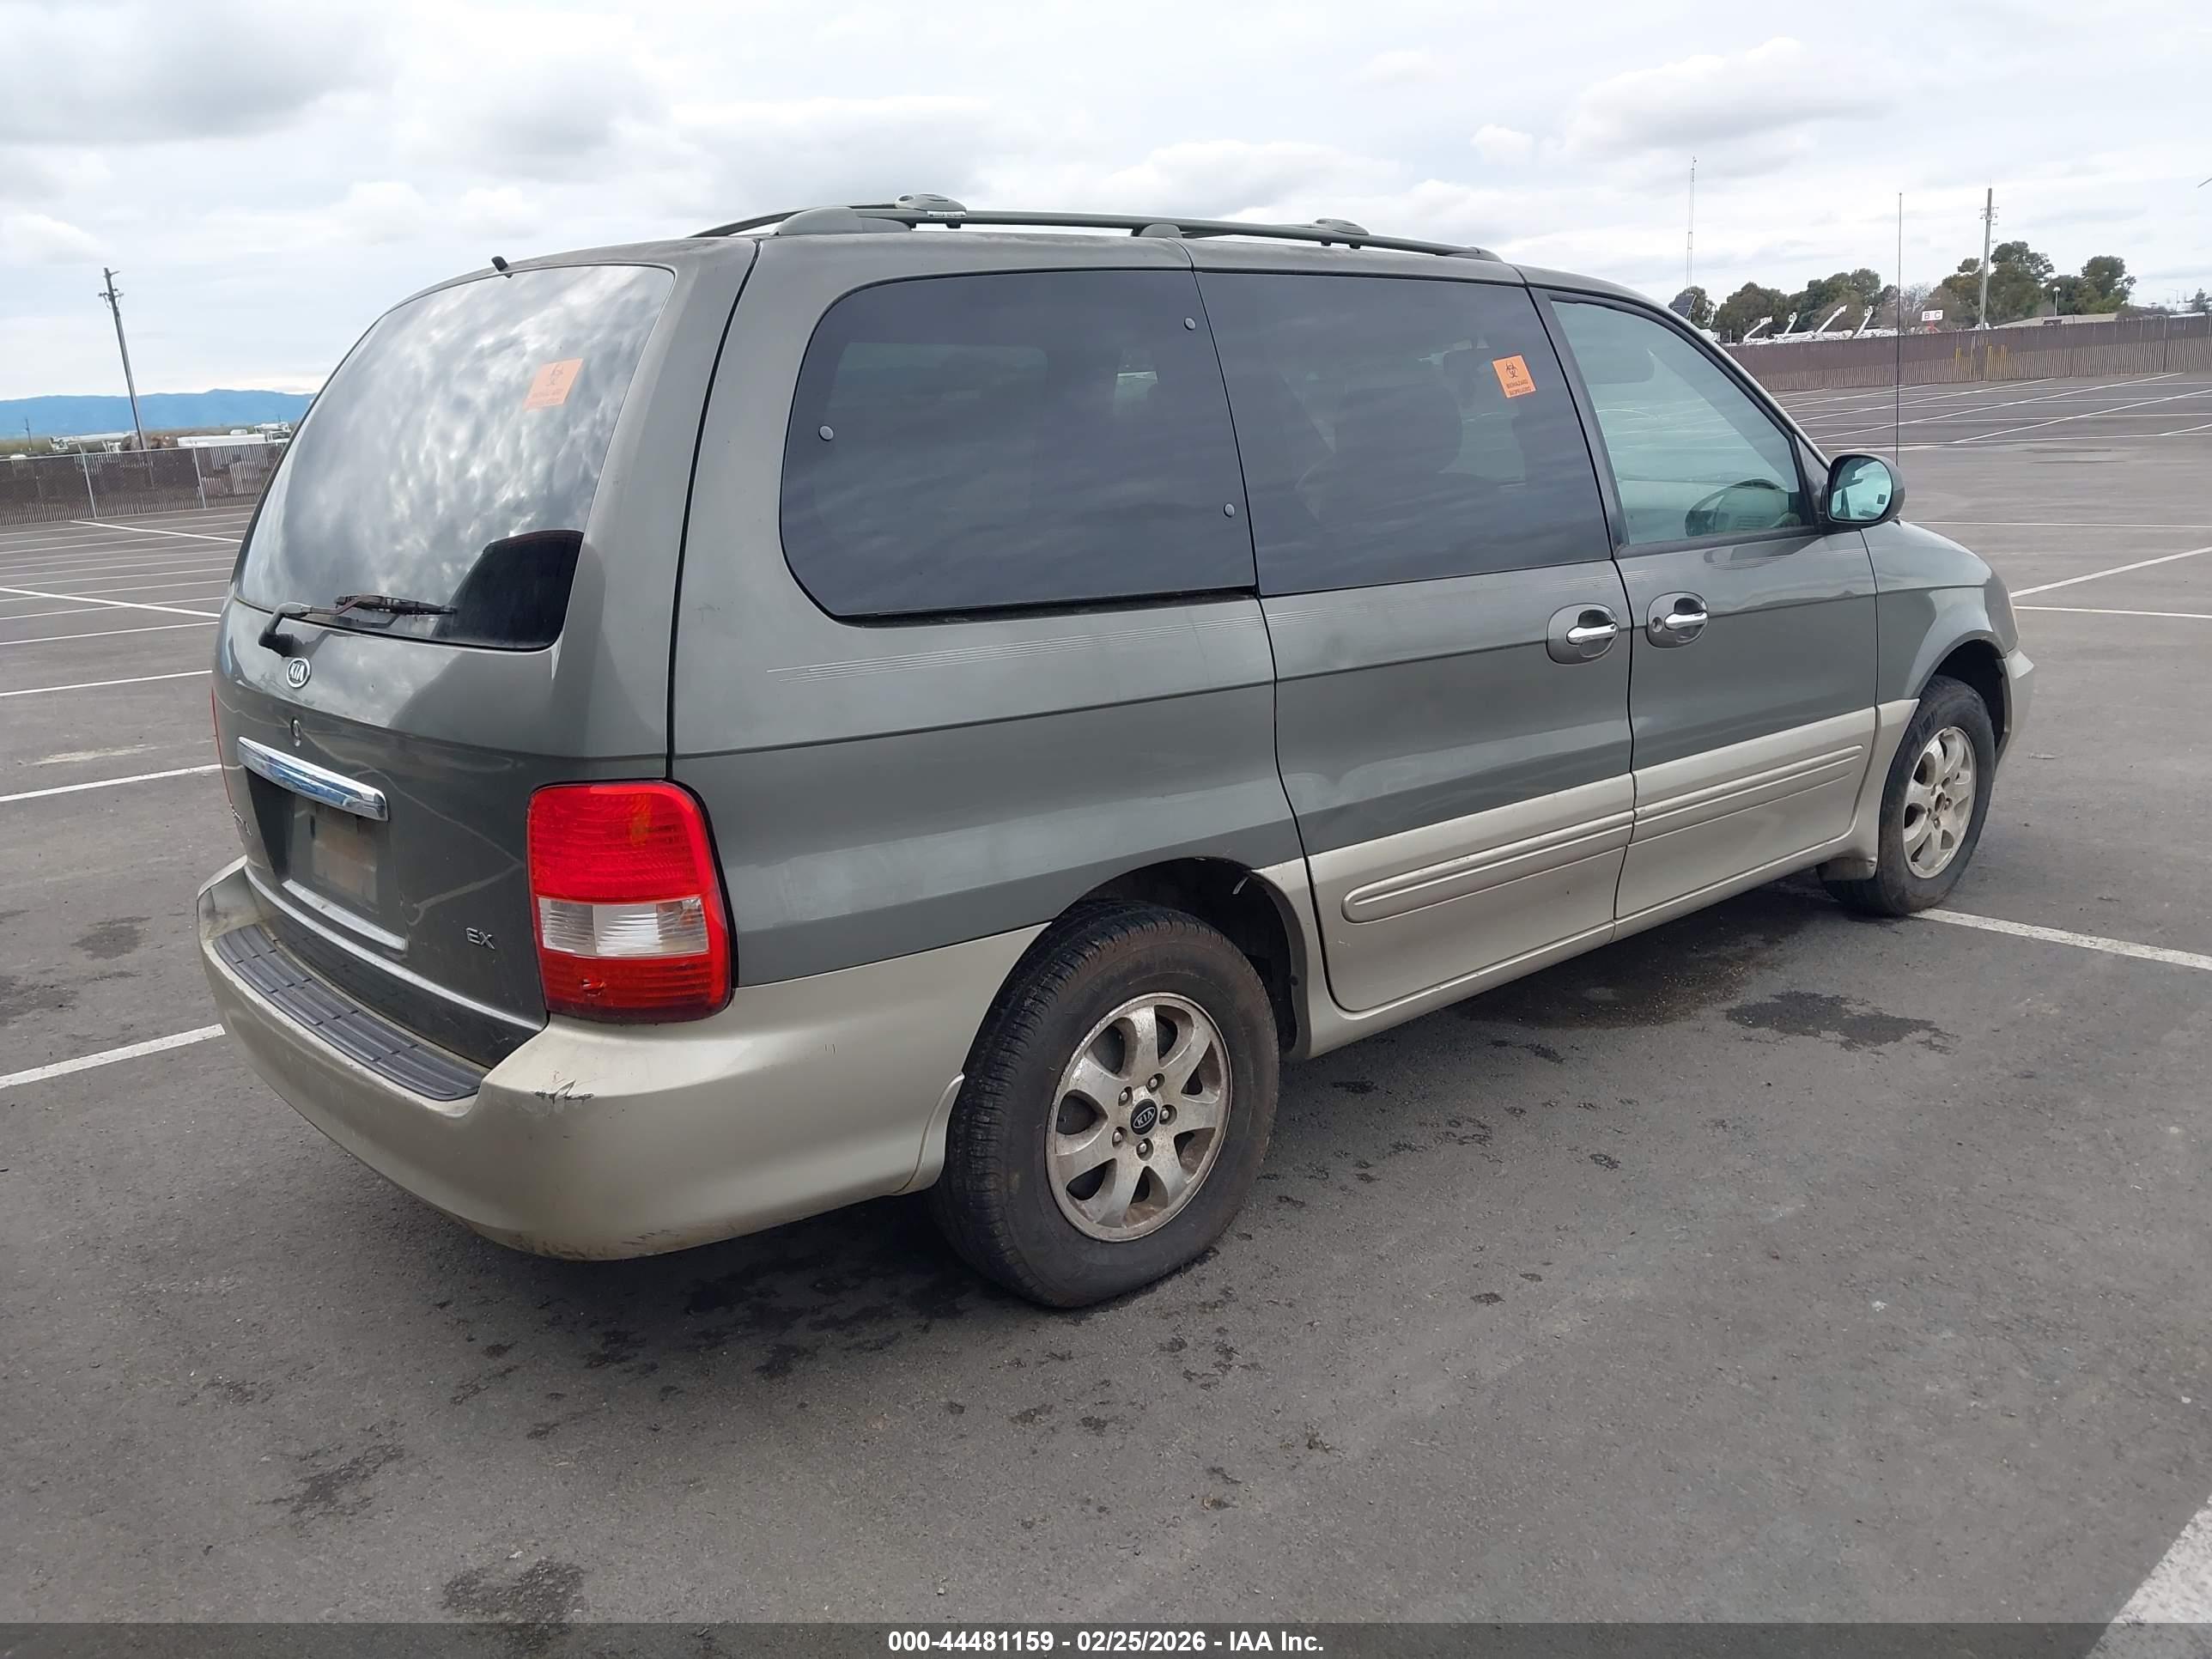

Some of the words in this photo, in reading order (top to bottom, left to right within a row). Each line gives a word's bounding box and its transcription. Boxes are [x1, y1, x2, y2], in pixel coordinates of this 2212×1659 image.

[289, 661, 307, 683] KIA
[465, 927, 495, 950] EX
[1136, 1109, 1154, 1127] KIA
